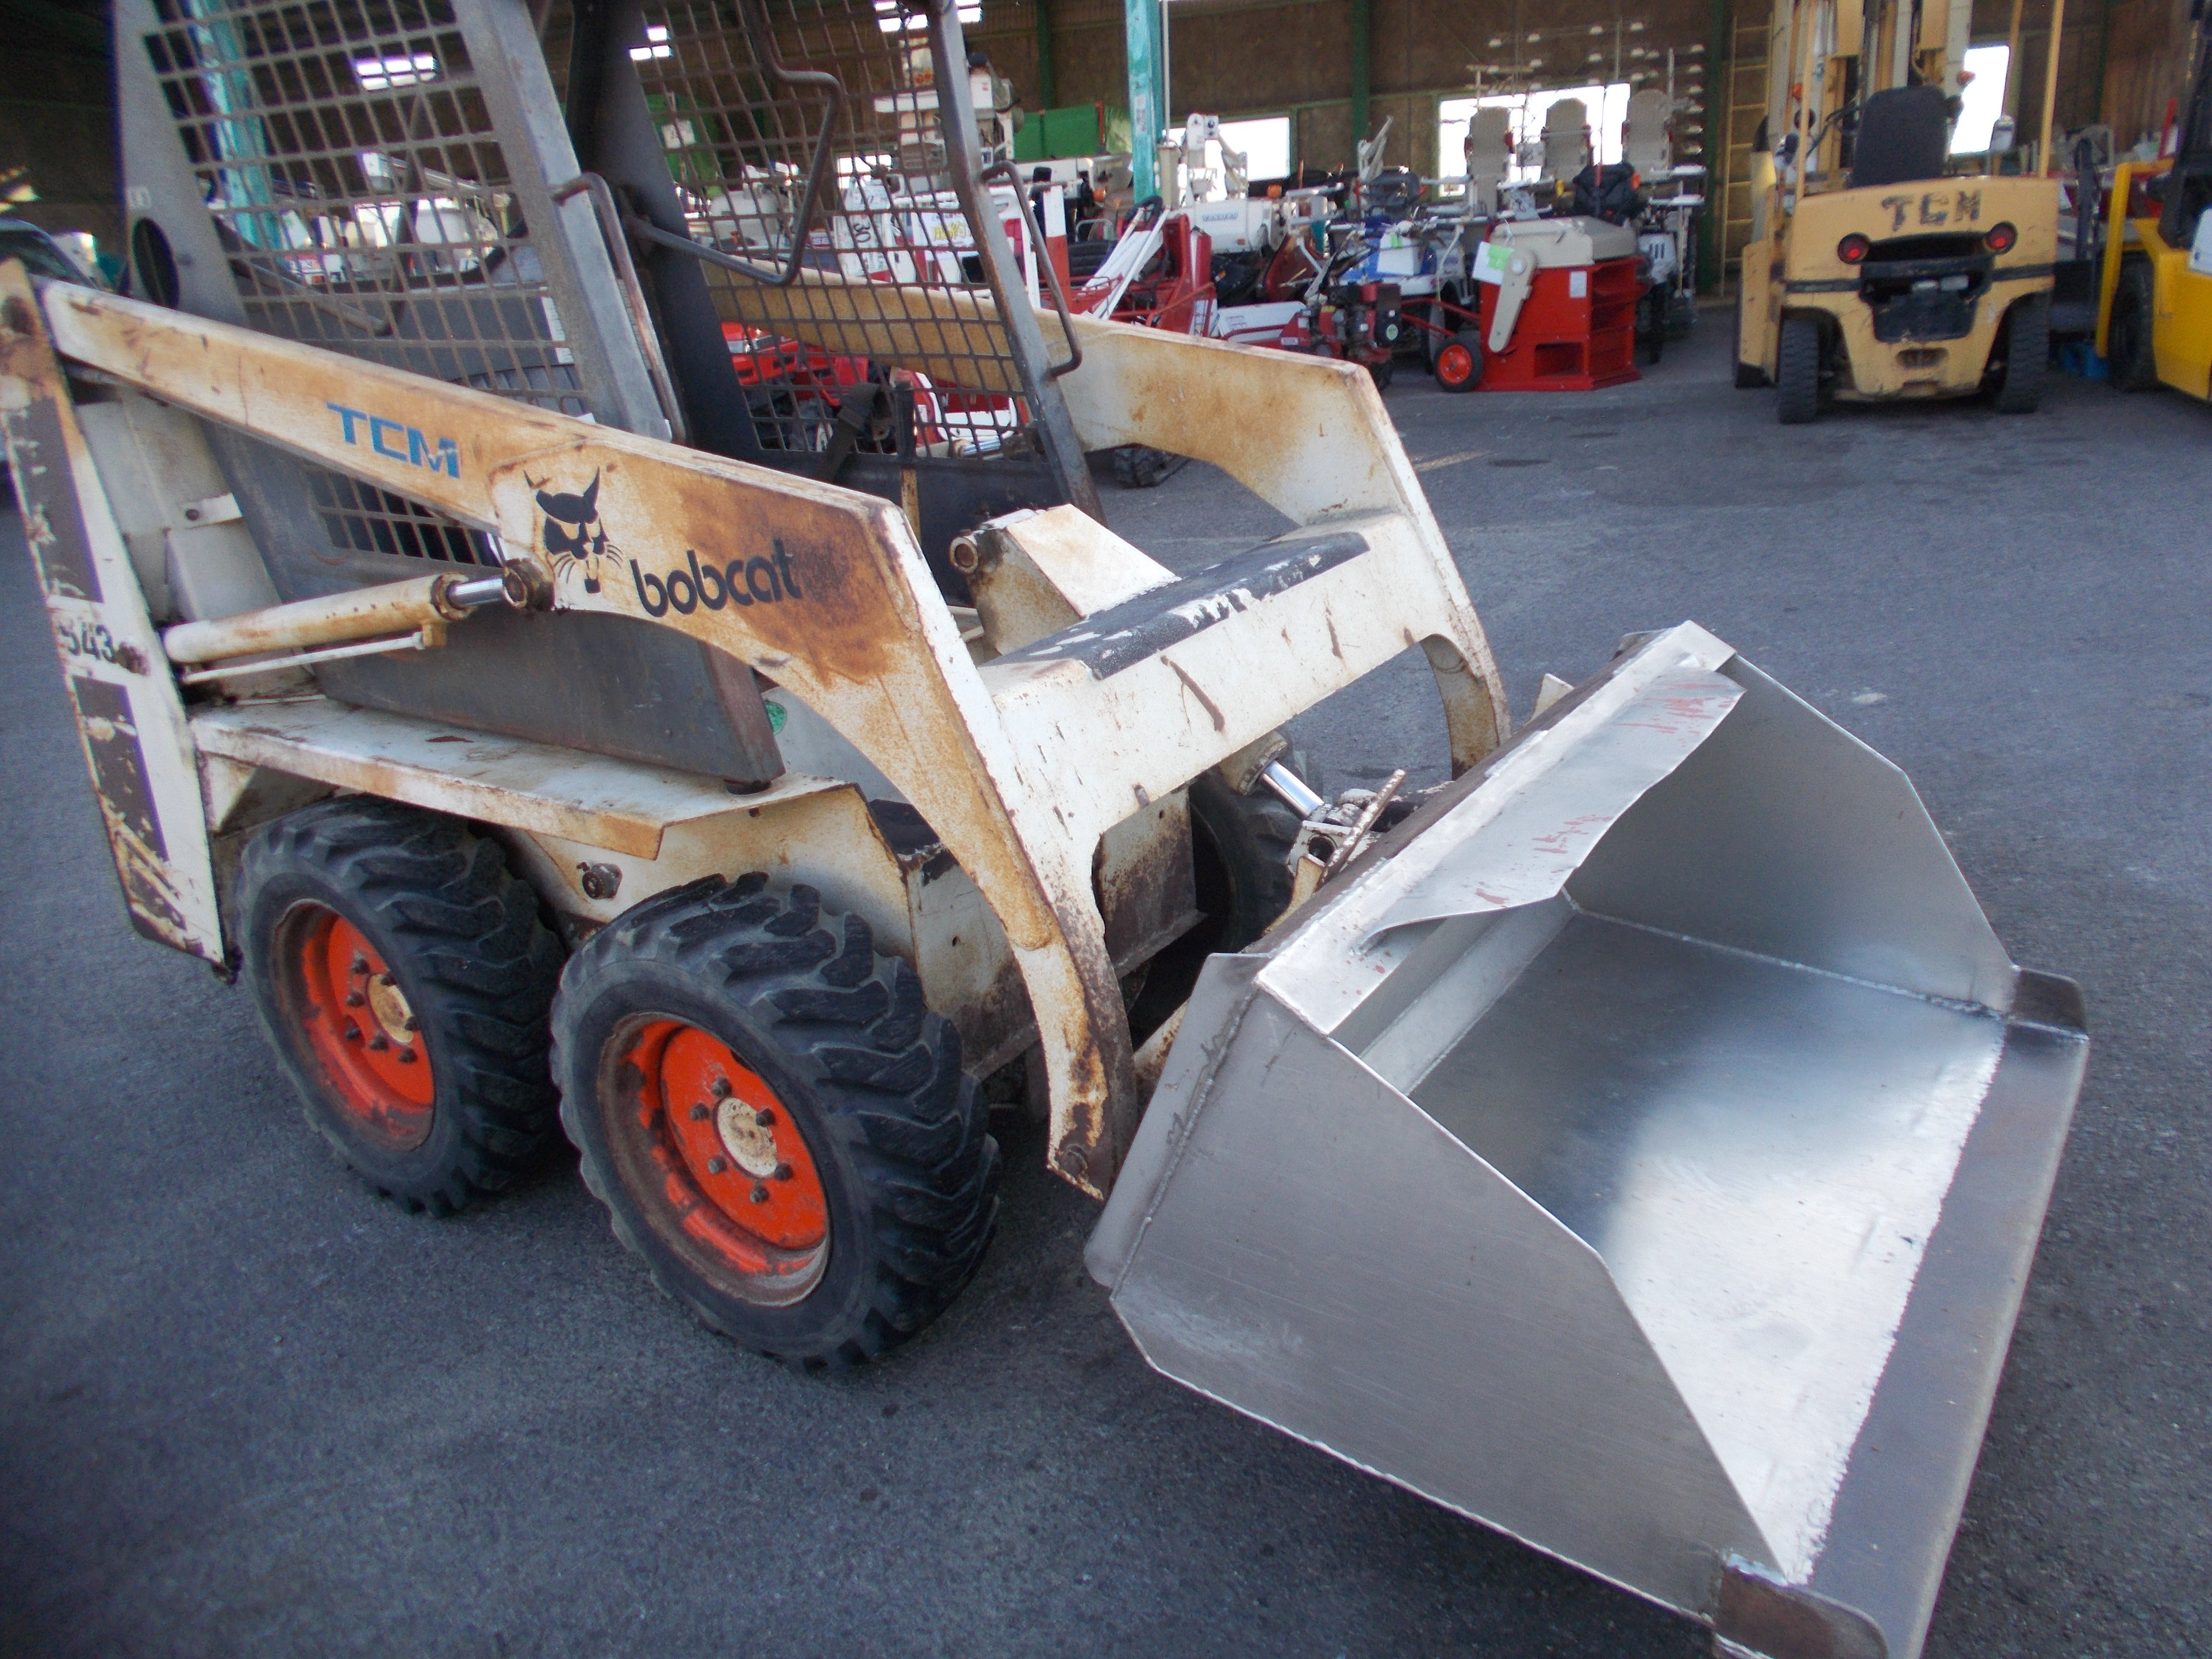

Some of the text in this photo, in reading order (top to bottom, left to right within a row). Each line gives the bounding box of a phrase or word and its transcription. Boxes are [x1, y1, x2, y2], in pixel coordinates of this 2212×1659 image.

[1882, 189, 1981, 232] TCM
[326, 400, 460, 480] TCM
[629, 537, 803, 618] bobcat
[58, 621, 117, 664] 543
